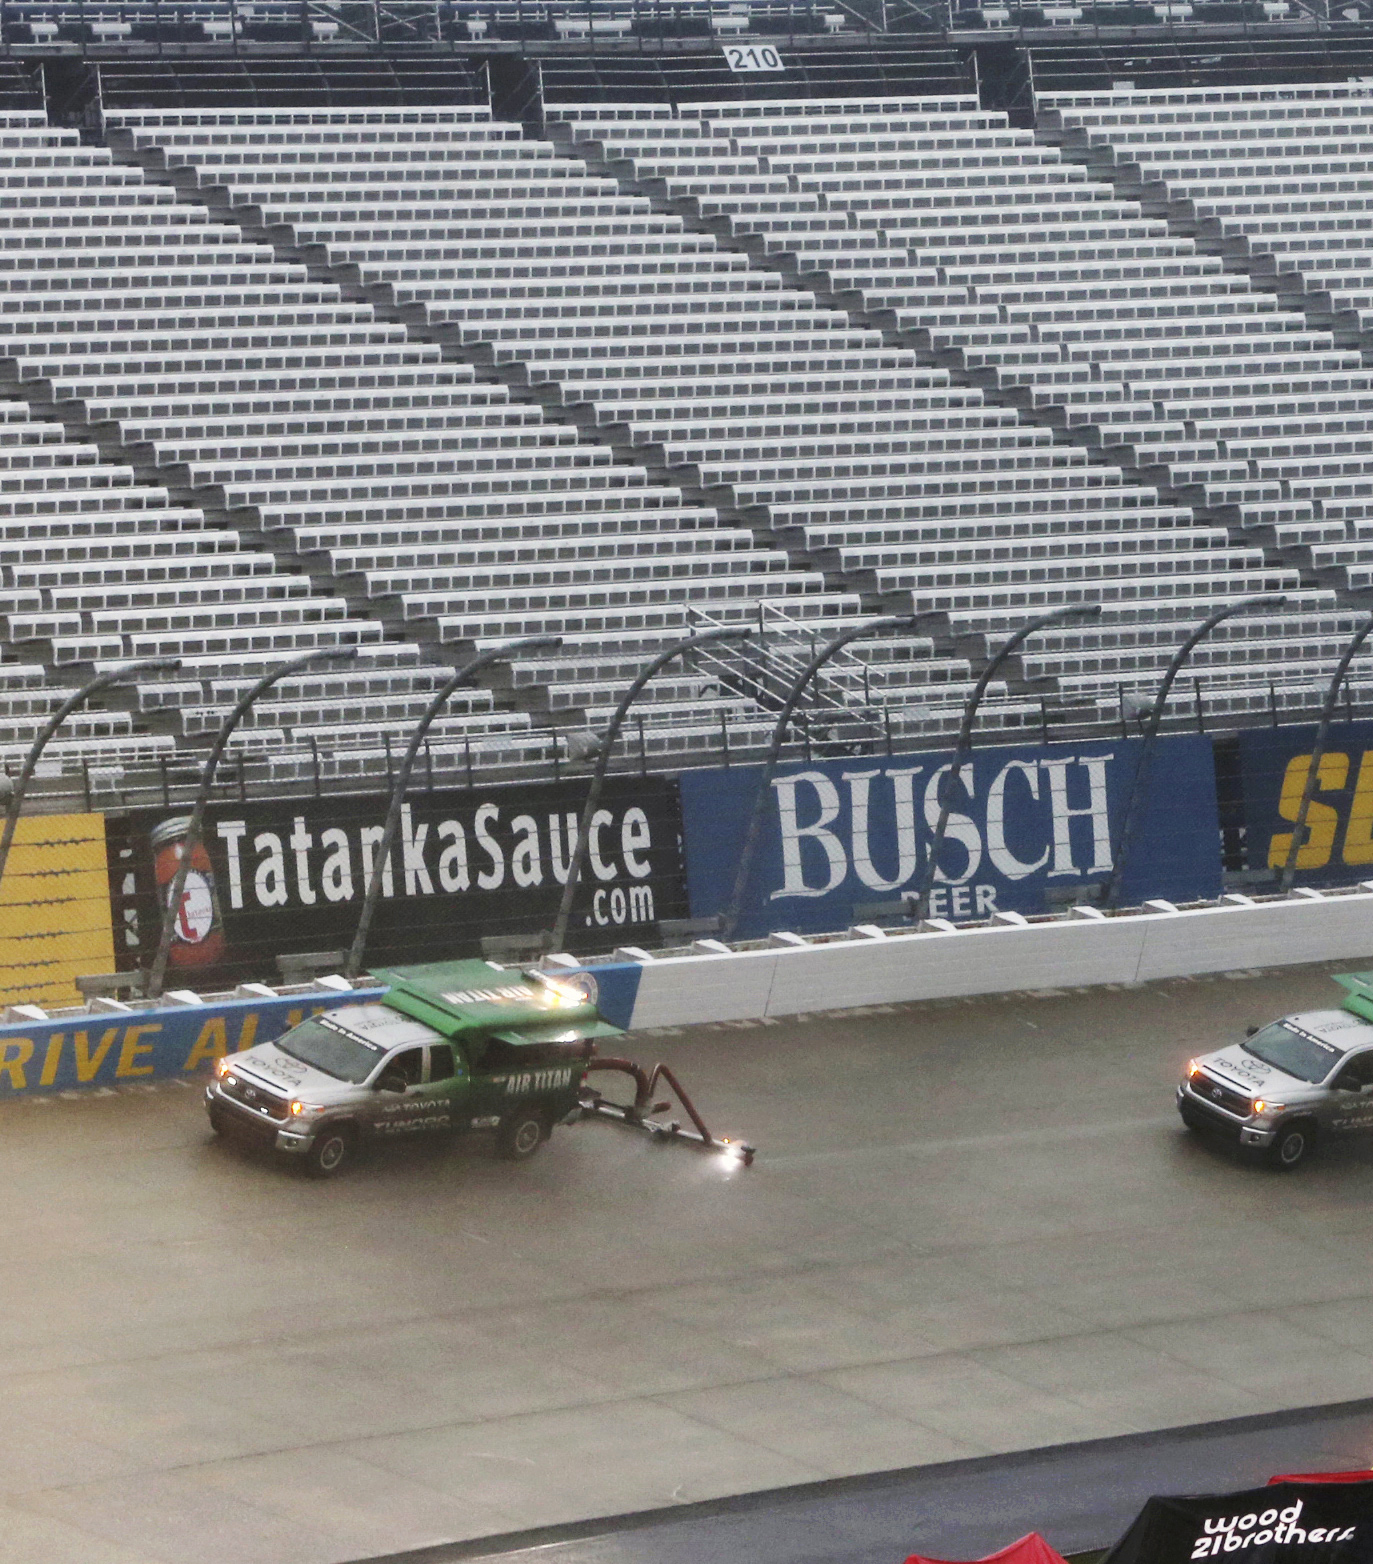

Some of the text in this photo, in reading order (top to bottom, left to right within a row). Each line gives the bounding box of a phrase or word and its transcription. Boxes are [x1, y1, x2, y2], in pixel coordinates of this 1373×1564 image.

[729, 48, 778, 68] 210
[770, 753, 1114, 900] BUSCH
[217, 803, 652, 909] TatankaSauce
[586, 885, 654, 927] .com
[246, 1056, 302, 1087] TOYOTA
[506, 1068, 571, 1094] AIR TITAN
[1214, 1057, 1266, 1087] TOYOTA
[1204, 1498, 1304, 1534] wood
